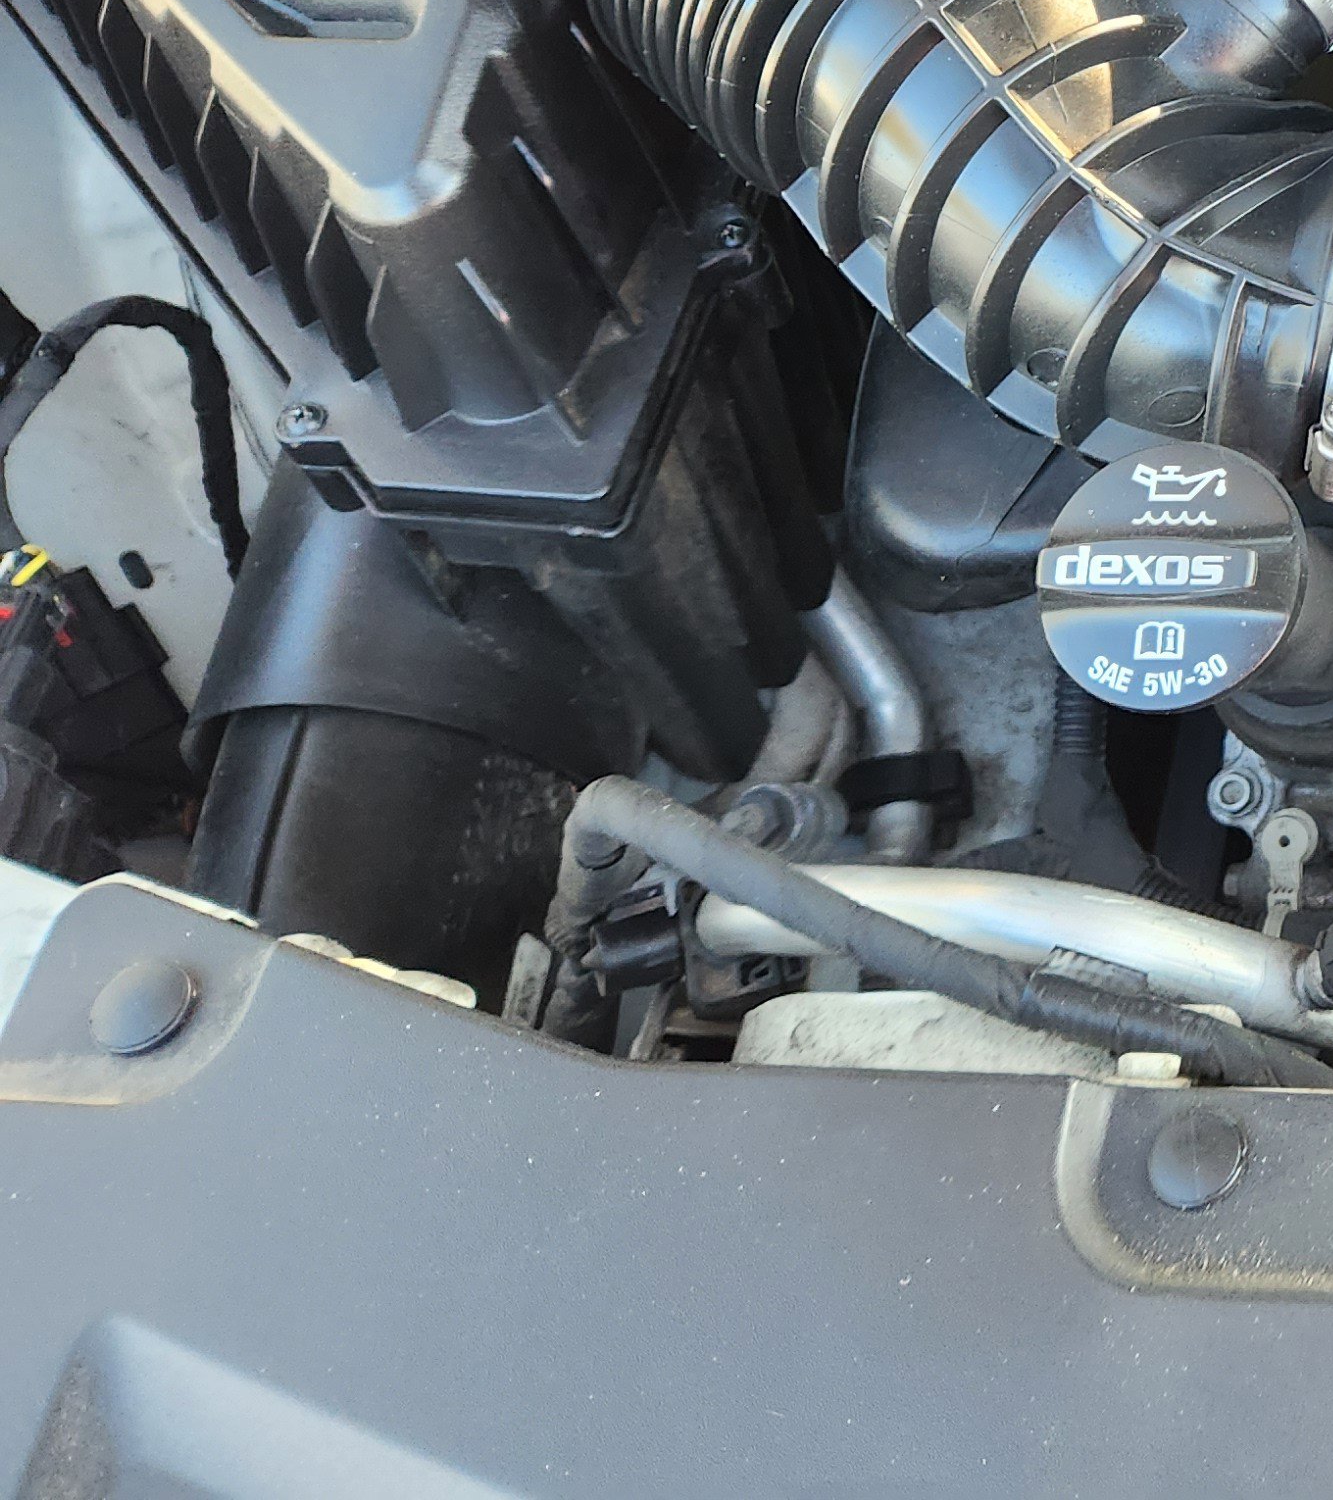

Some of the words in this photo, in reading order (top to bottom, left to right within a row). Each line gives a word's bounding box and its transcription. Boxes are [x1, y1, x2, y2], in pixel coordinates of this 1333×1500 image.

[1054, 545, 1225, 586] dexos
[1088, 655, 1134, 693] SAE
[1142, 653, 1228, 696] 5W-30
